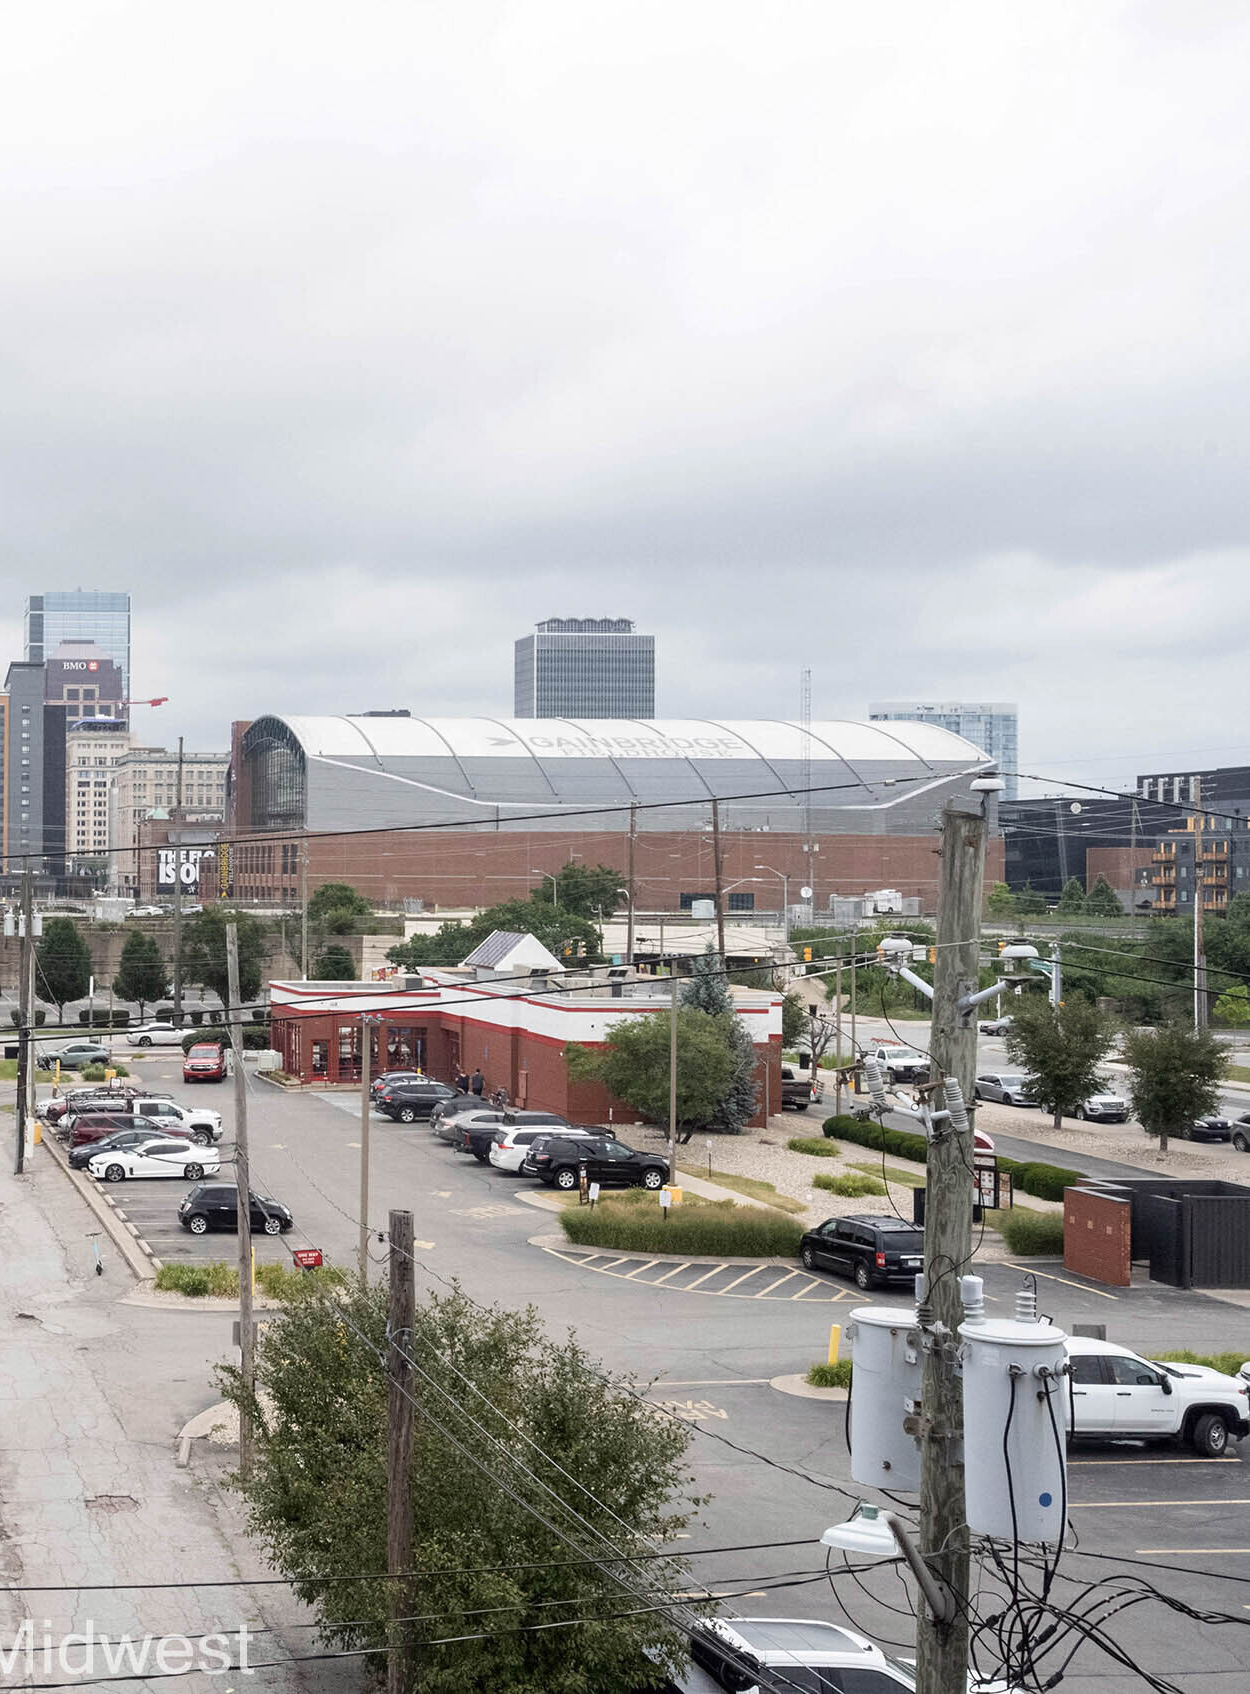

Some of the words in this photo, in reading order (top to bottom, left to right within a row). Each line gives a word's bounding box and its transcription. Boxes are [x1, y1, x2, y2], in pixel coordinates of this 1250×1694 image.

[63, 662, 87, 670] BMO
[529, 736, 743, 750] GAINBRIDGE
[158, 850, 187, 863] THE
[159, 862, 176, 884] IS
[221, 843, 229, 889] GAINBRIDGE
